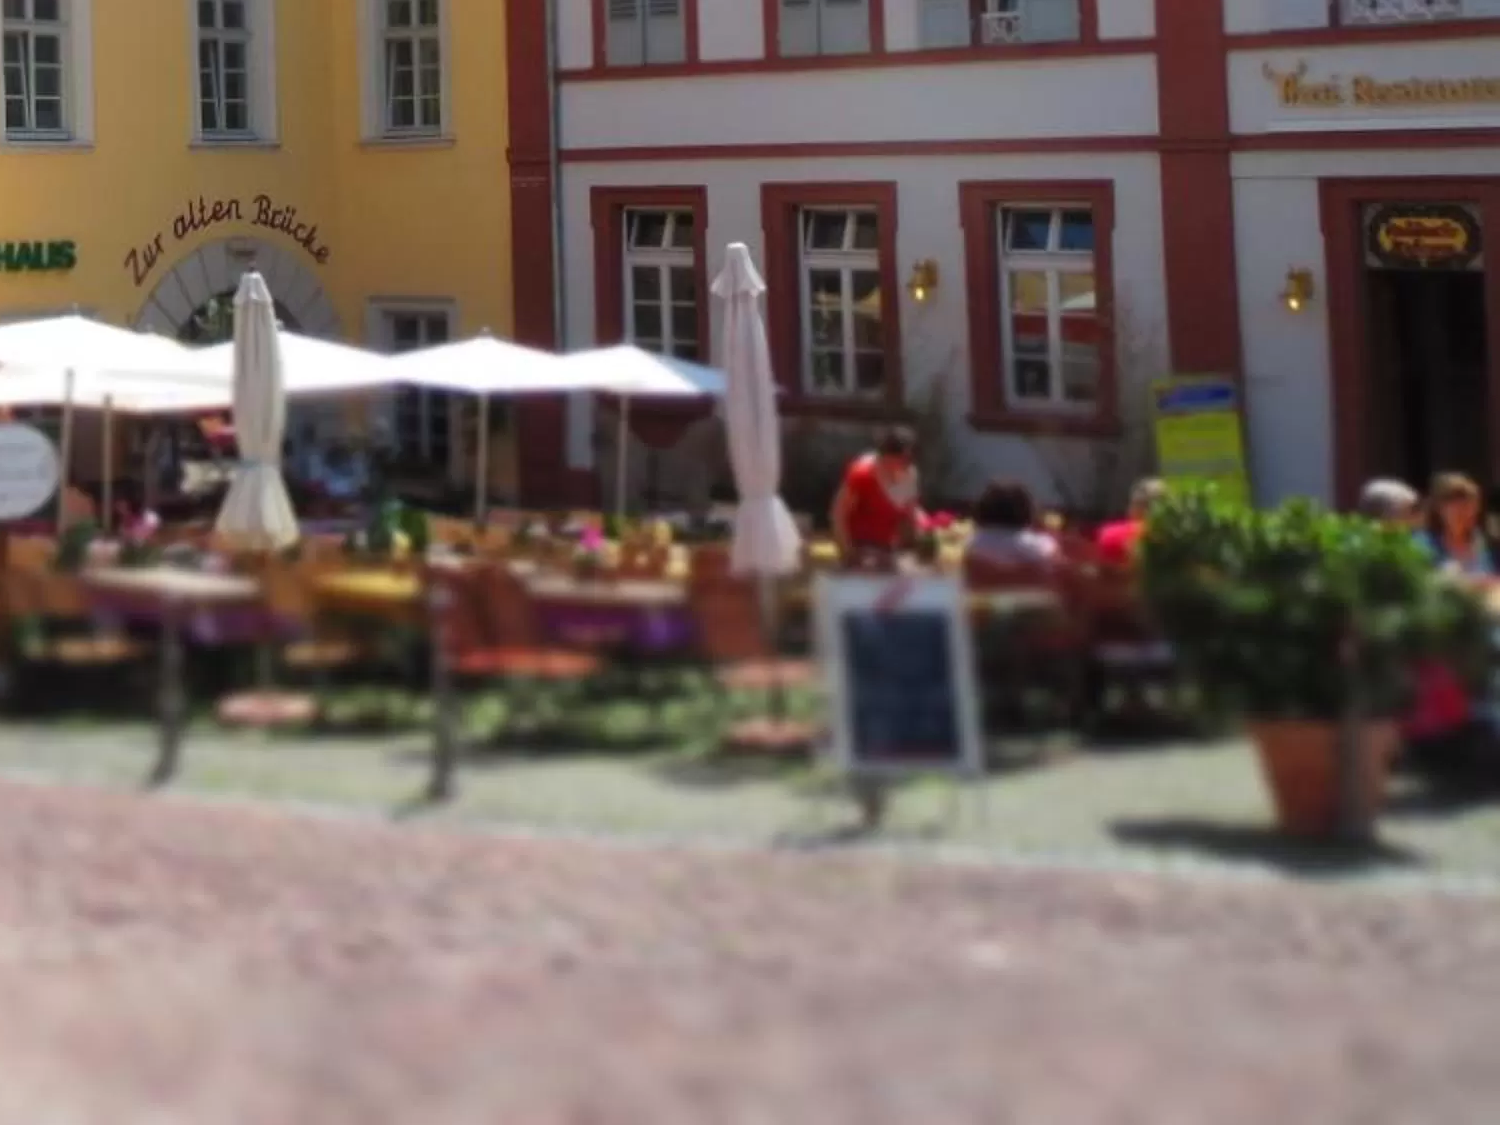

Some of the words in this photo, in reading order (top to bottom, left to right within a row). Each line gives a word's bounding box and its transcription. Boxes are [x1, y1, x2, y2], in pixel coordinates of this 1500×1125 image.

[123, 231, 165, 287] Zur
[172, 194, 243, 240] alten
[251, 193, 330, 264] Brücke
